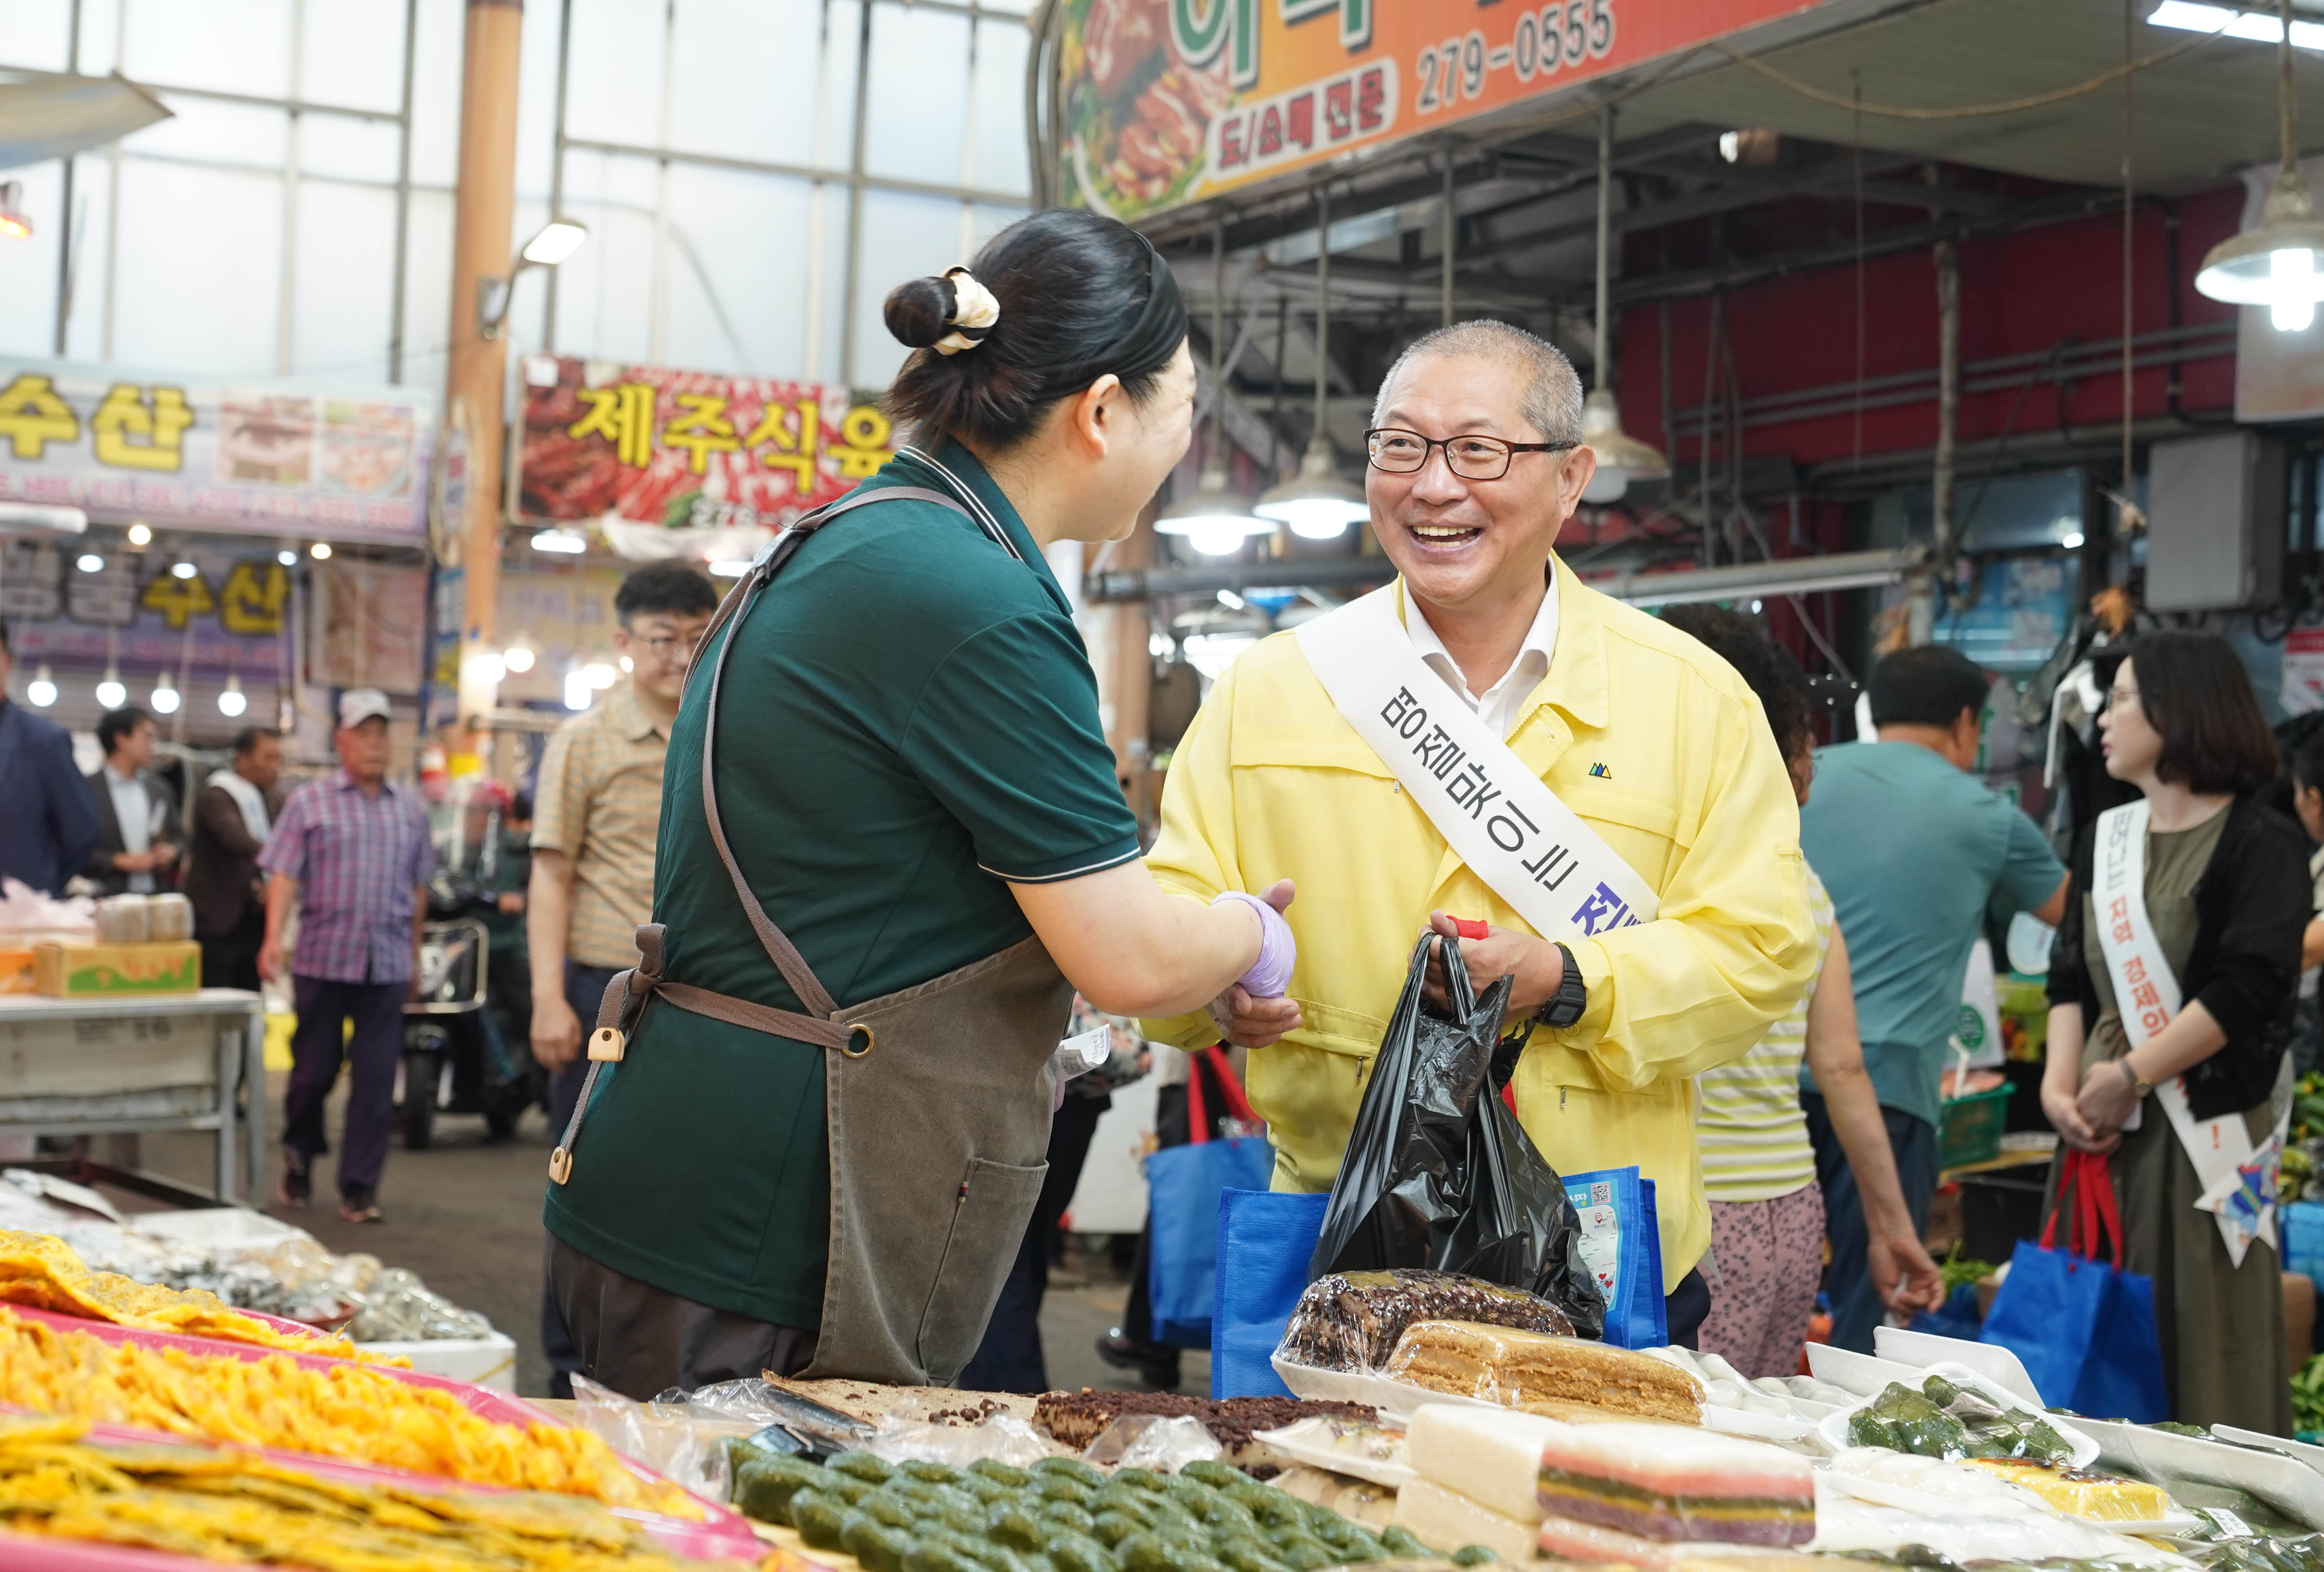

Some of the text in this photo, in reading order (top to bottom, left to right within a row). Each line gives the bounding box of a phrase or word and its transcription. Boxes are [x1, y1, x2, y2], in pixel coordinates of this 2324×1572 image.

[1417, 0, 1614, 115] 279-0555
[1325, 69, 1384, 141] 전문
[1381, 686, 1646, 938] 명절맞이는 전
[2109, 896, 2135, 946] 지역
